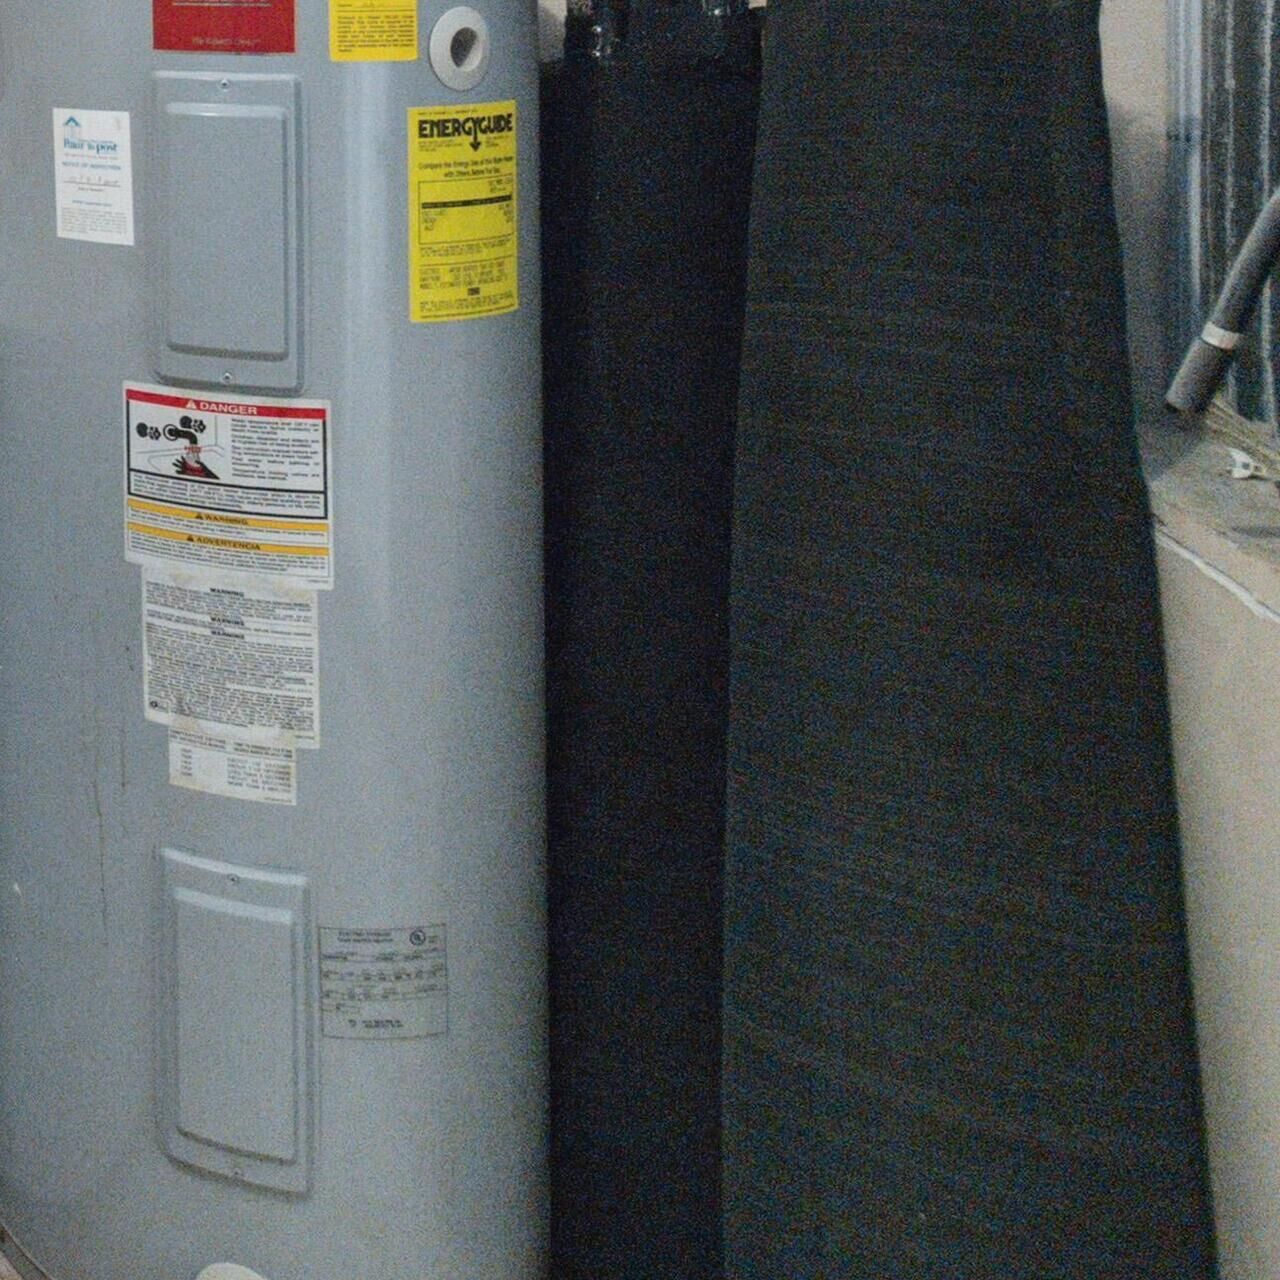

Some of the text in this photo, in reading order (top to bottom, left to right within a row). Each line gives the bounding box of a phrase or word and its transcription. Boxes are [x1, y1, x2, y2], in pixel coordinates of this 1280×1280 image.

[418, 112, 513, 139] ENERGYGUIDE
[199, 401, 258, 415] DANGER
[204, 513, 249, 525] WARNING
[196, 536, 261, 550] ADVERTENCIA
